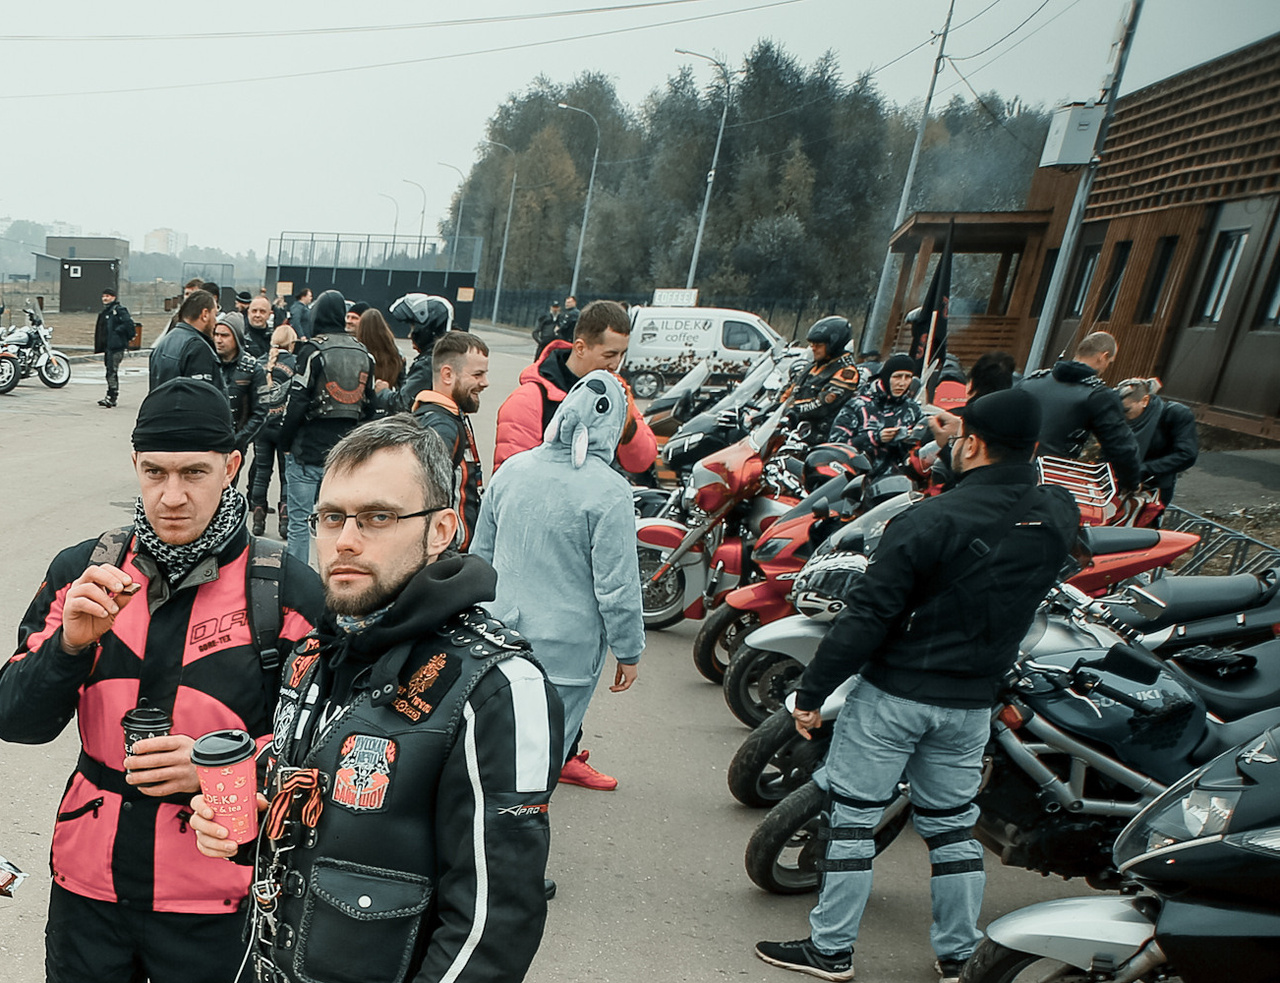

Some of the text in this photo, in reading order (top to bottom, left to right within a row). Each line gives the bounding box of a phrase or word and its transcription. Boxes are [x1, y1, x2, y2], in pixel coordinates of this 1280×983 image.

[665, 332, 699, 342] coffee
[198, 634, 232, 652] GORE-TEX
[228, 804, 242, 813] tea
